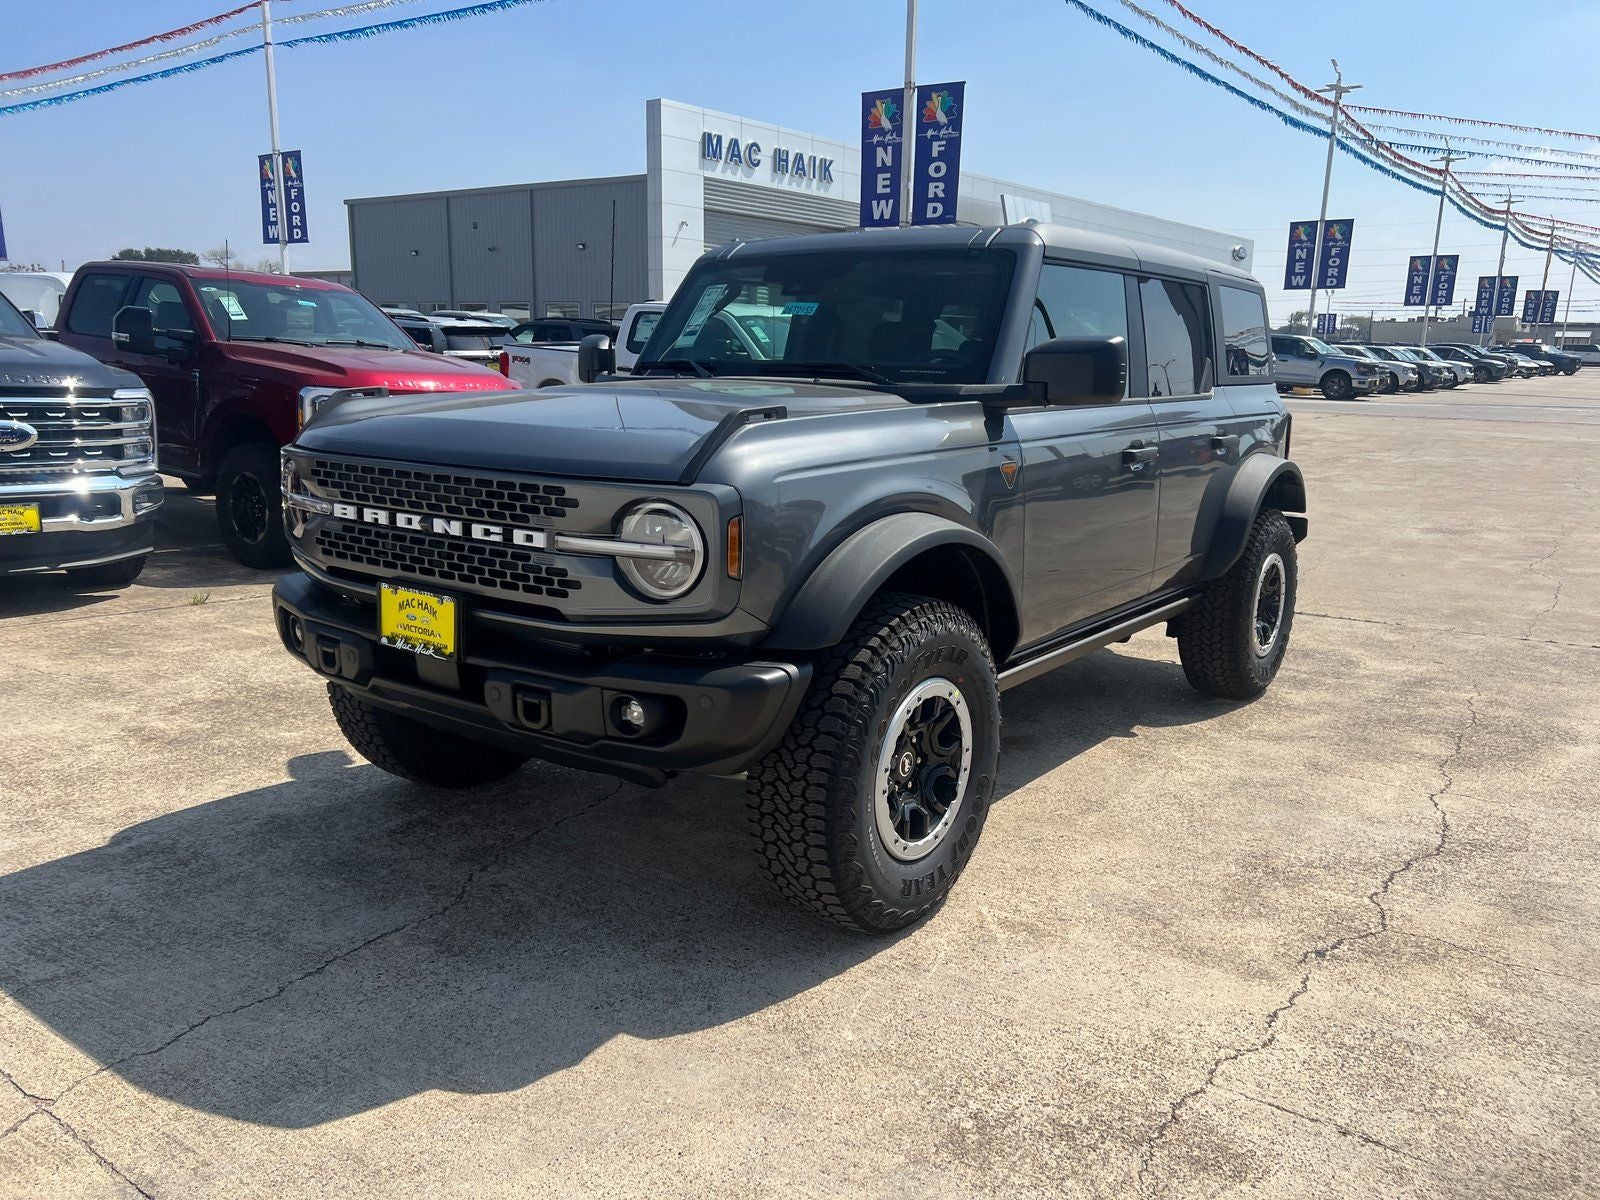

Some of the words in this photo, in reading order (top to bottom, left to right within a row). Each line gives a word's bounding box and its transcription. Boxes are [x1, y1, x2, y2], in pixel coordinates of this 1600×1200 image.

[702, 131, 762, 168] MAC
[774, 146, 835, 184] HAIK
[871, 146, 894, 220] NEW
[926, 140, 947, 219] FORD
[267, 190, 279, 239] NEW
[290, 188, 302, 240] FORD
[1291, 248, 1307, 287] NEW
[1325, 247, 1341, 287] FORD
[1409, 275, 1423, 304] NEW
[1436, 275, 1449, 304] FORD
[1479, 291, 1490, 314] NEW
[1501, 291, 1510, 315] FORD
[1525, 303, 1535, 322] NEW
[1543, 301, 1552, 322] FORD
[333, 503, 547, 549] BRONCO
[398, 598, 416, 613] MAC
[417, 599, 438, 620] HAIK
[401, 622, 436, 638] VICTORIA
[394, 637, 412, 650] Mac
[414, 642, 440, 657] Haik
